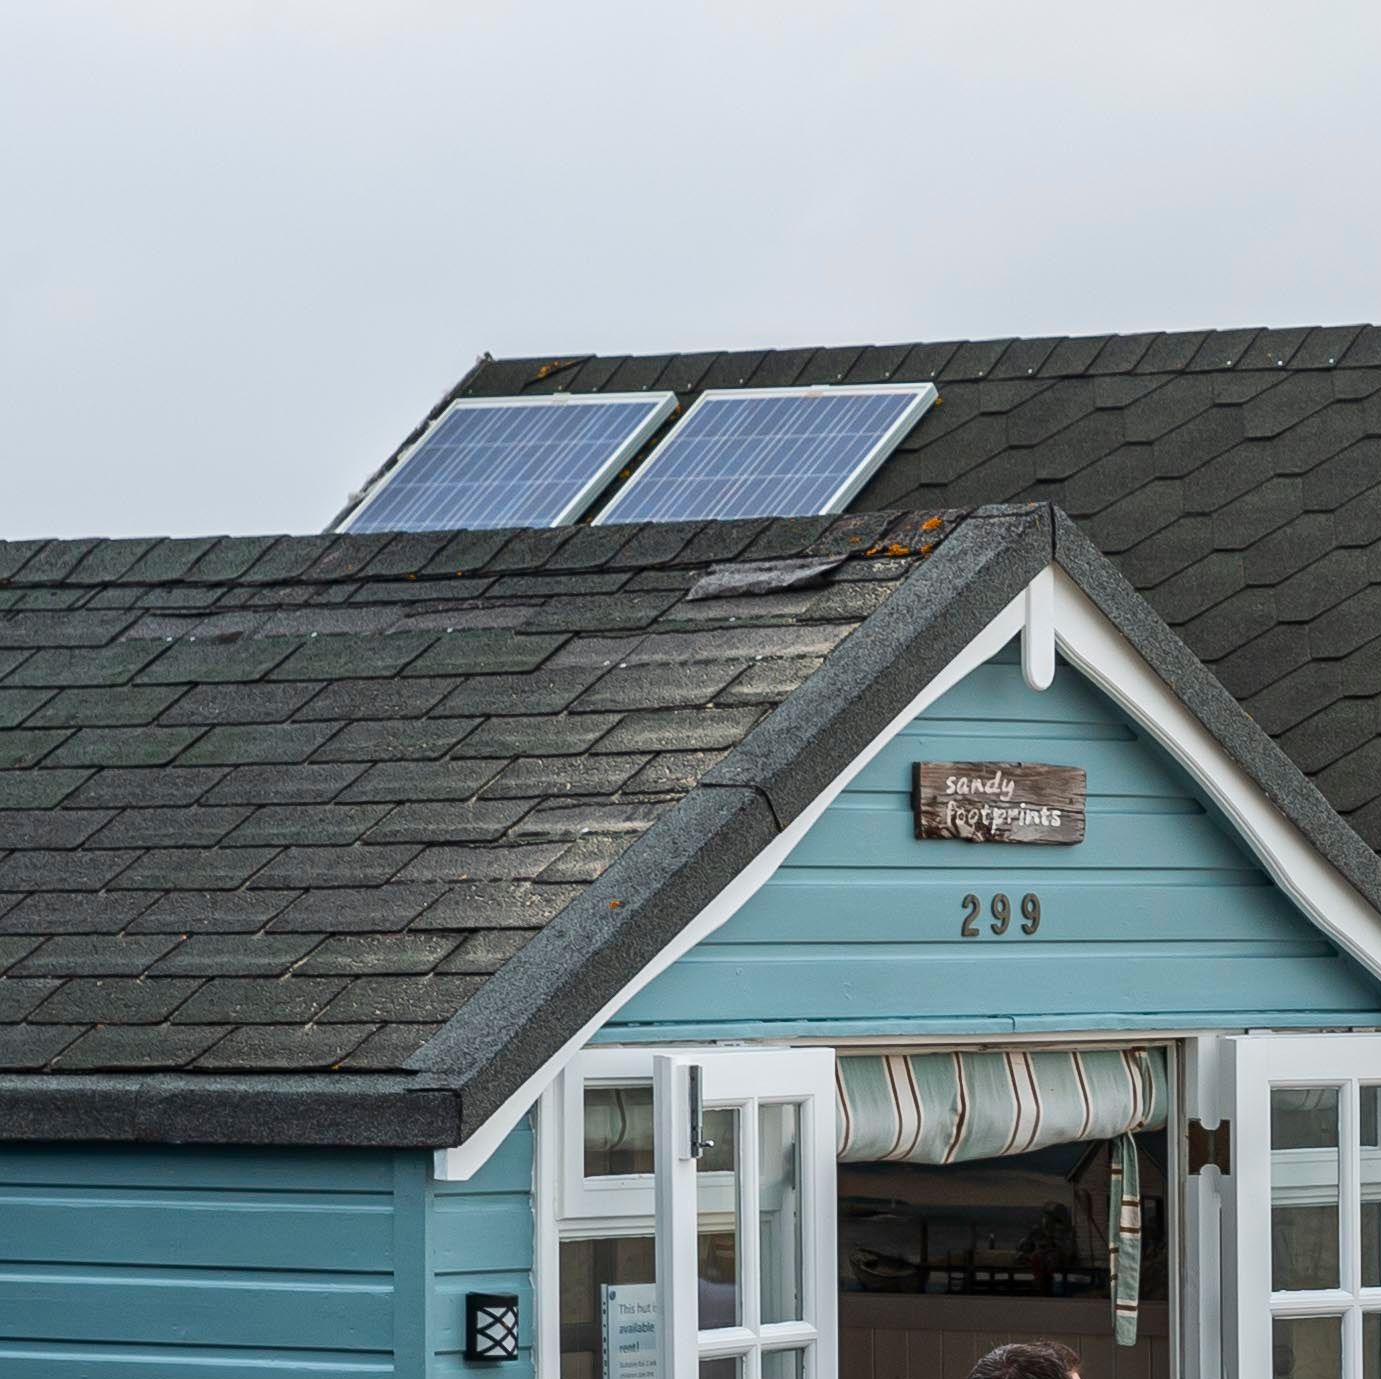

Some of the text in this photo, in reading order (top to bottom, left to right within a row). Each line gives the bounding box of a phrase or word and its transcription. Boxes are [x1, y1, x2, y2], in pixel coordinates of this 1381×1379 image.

[946, 771, 1015, 799] sandy
[946, 801, 1062, 833] footprints
[961, 893, 1041, 937] 299
[619, 1303, 635, 1314] This
[619, 1322, 655, 1334] available
